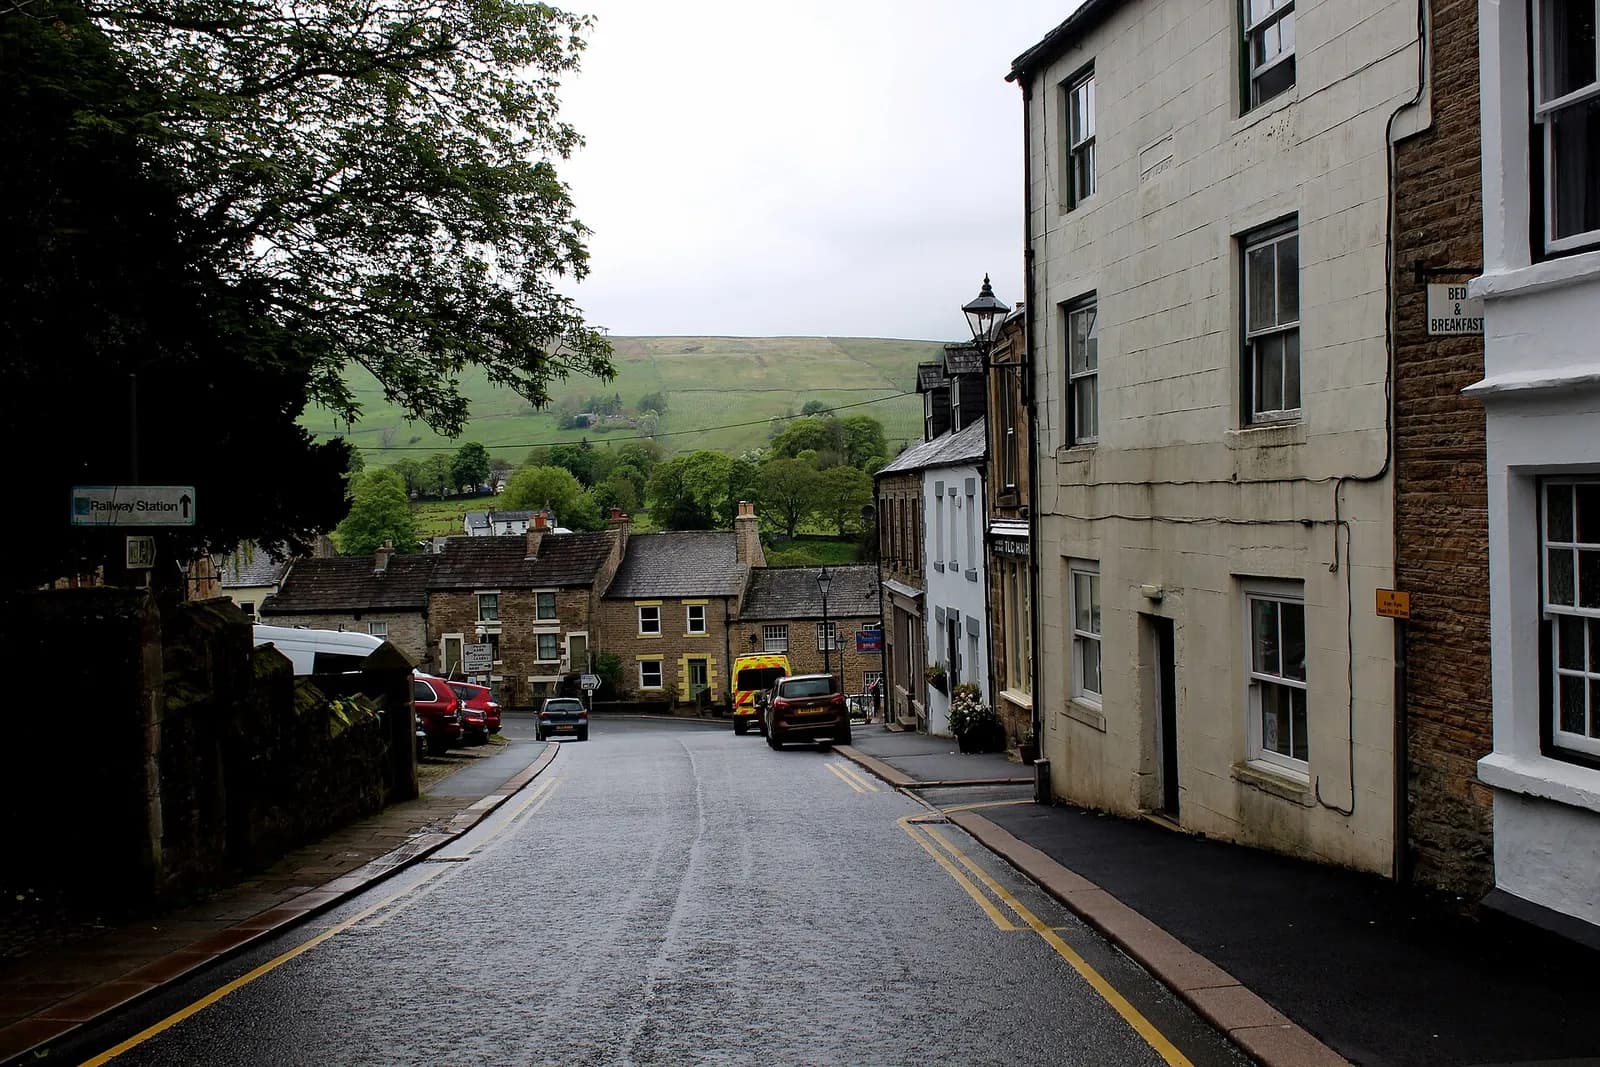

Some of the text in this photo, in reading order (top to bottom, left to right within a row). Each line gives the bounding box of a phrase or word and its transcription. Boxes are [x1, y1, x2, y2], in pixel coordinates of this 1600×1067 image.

[1448, 287, 1467, 300] BED
[1454, 302, 1461, 315] &
[1431, 318, 1484, 331] BREAKFAST
[90, 500, 178, 513] Railway Station
[1004, 540, 1015, 553] TLC
